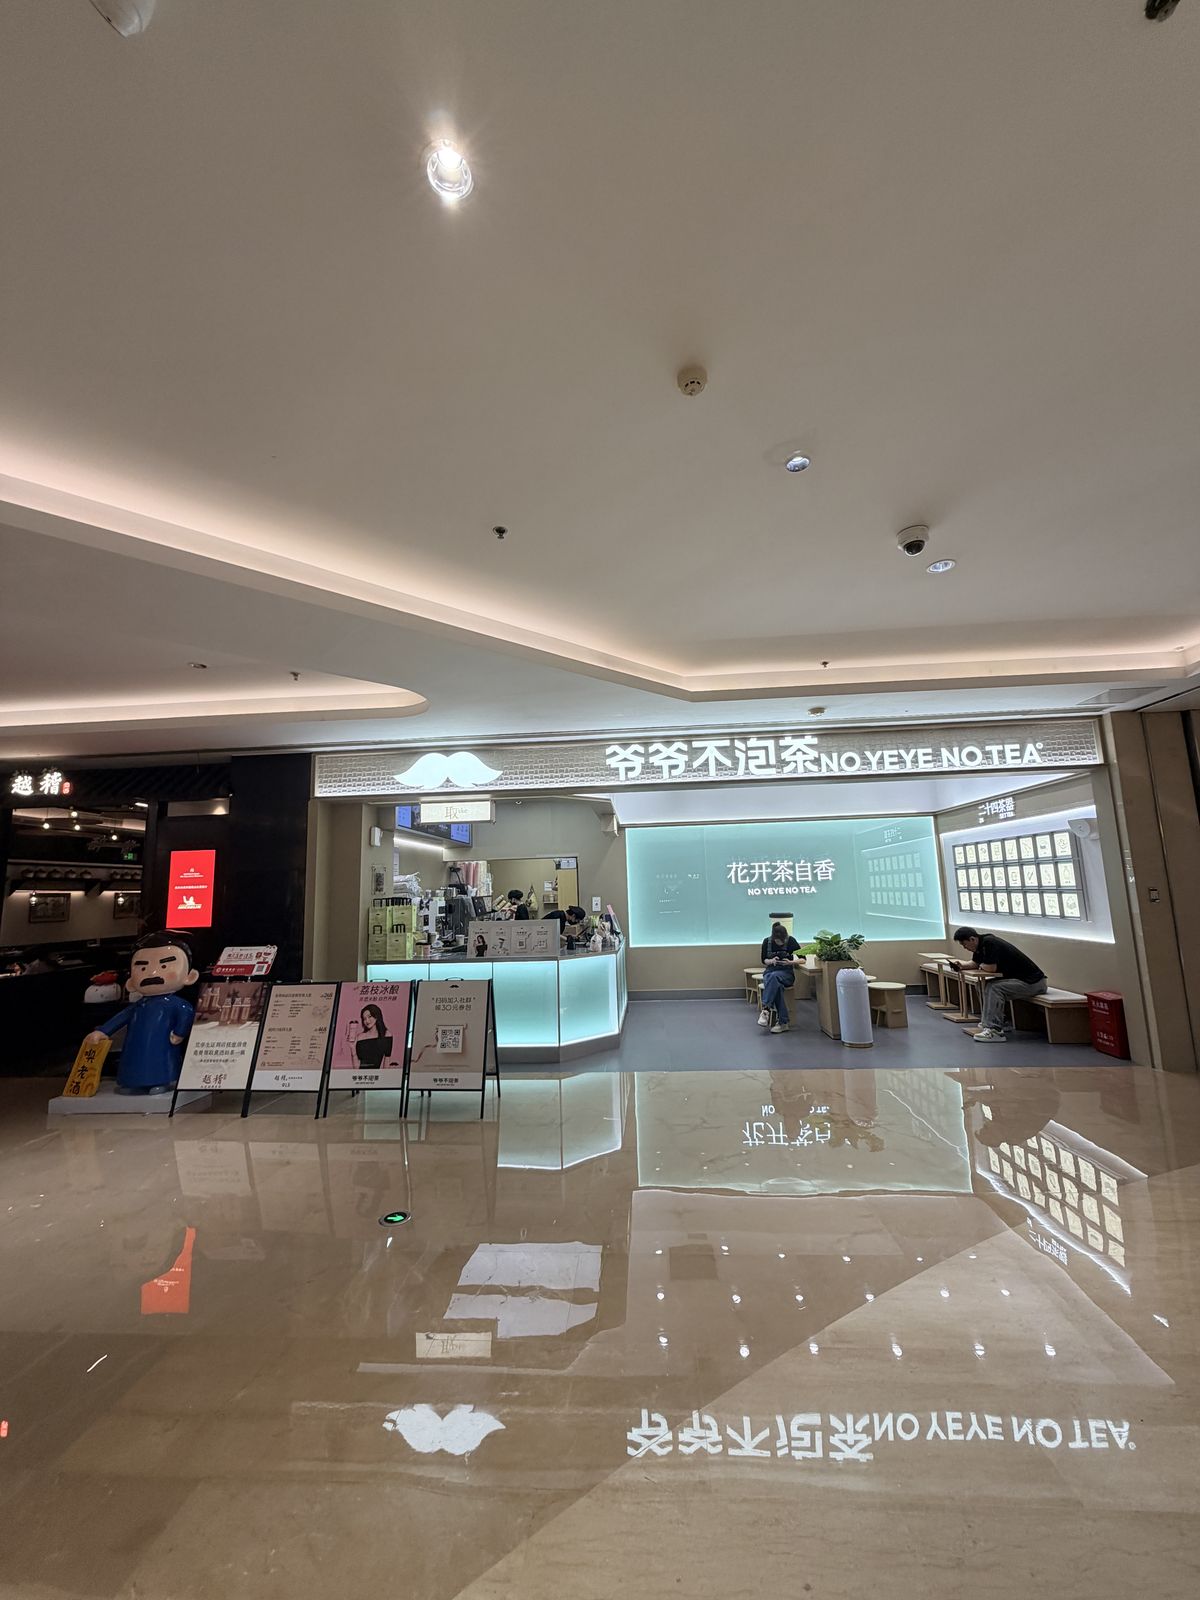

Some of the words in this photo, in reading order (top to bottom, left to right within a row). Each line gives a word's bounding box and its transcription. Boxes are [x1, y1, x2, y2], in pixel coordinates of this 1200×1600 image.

[605, 736, 820, 781] 爷爷不泡茶
[820, 750, 862, 773] NO
[864, 748, 935, 771] YEYE
[940, 745, 983, 767] NO
[726, 858, 836, 884] 花开茶自香
[747, 888, 761, 896] NO
[762, 887, 785, 895] YEYE
[785, 886, 799, 894] NO
[800, 886, 817, 894] TEA
